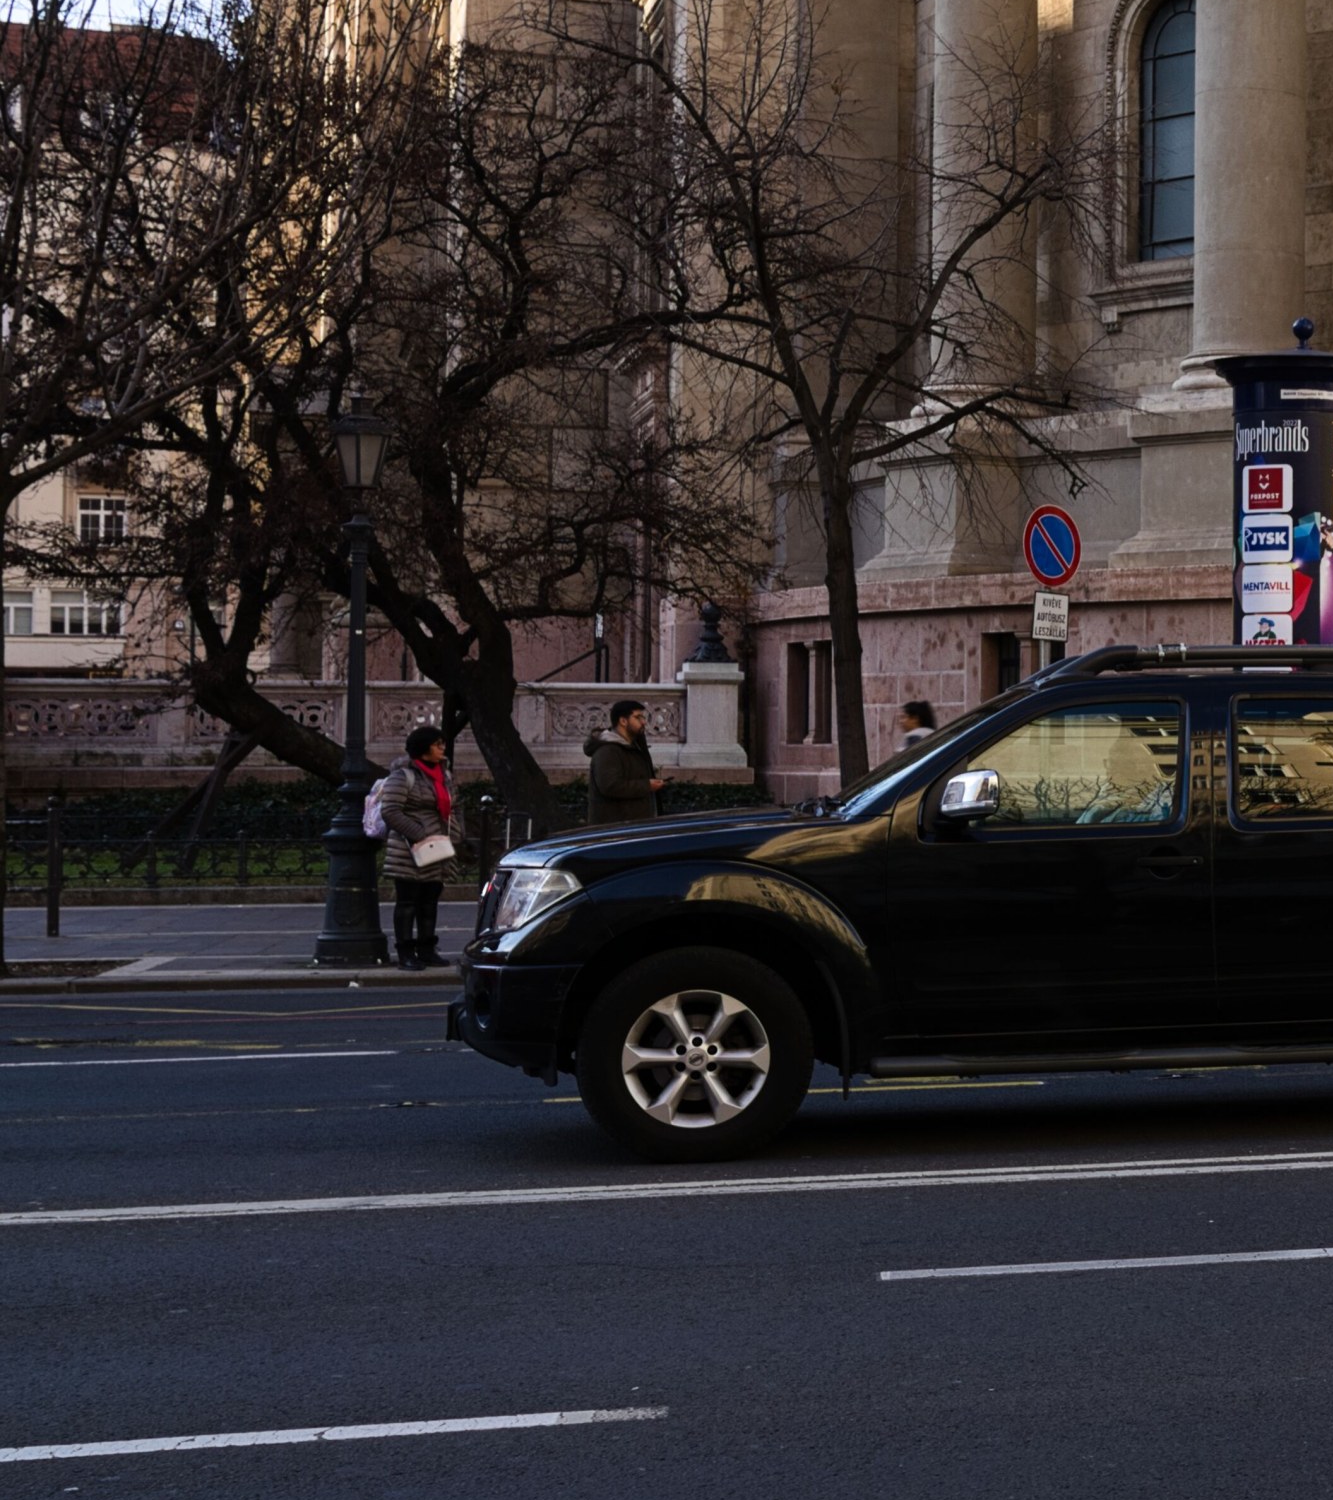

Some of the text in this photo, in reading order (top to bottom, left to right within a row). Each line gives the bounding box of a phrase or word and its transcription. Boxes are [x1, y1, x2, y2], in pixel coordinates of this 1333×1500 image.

[1235, 419, 1310, 461] Superbrands
[1250, 492, 1280, 500] FOXPOST
[1251, 531, 1287, 546] JYSK
[1243, 582, 1290, 591] MENTAVILL
[1042, 596, 1062, 609] KIVÉVE
[1036, 610, 1066, 624] AUTÓBUSZ
